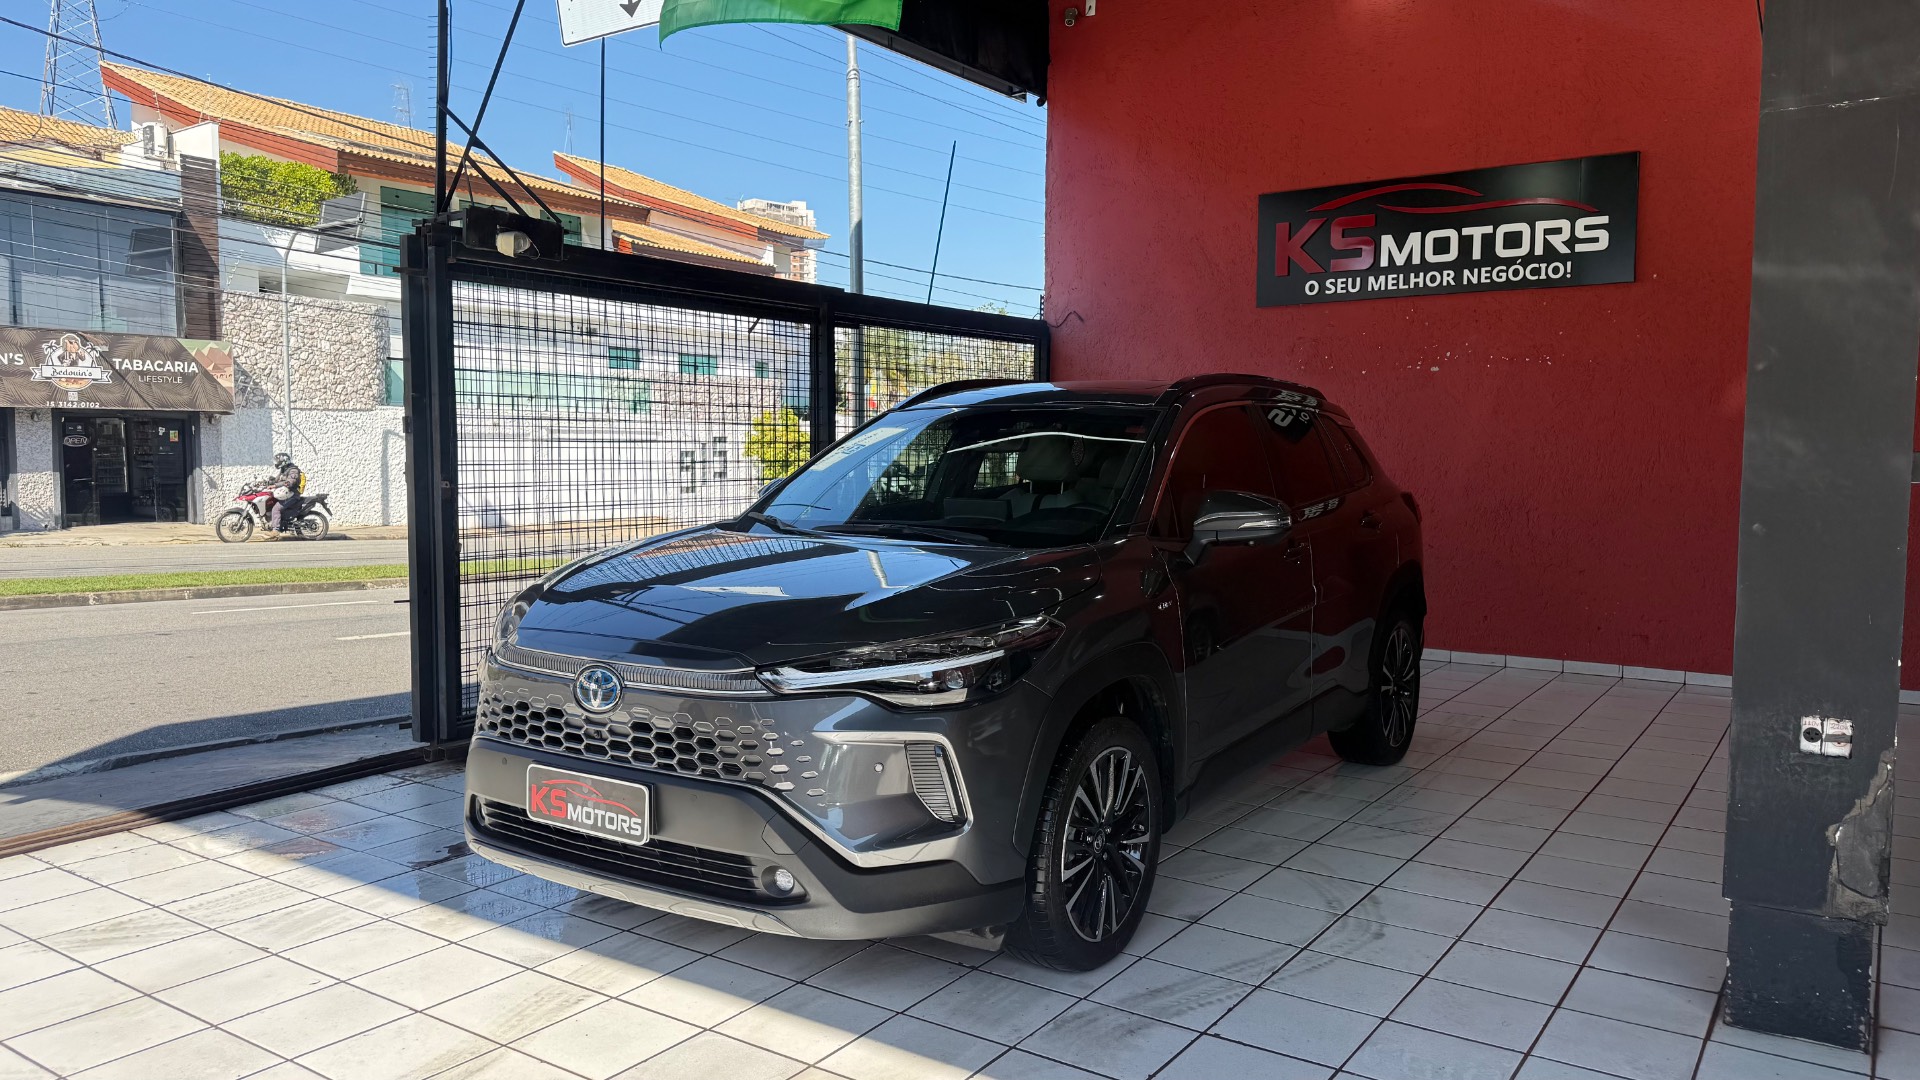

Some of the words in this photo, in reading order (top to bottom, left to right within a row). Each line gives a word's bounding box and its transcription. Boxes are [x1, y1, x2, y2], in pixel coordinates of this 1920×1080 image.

[1274, 213, 1376, 277] KS
[1380, 215, 1610, 268] MOTORS
[1304, 279, 1321, 296] O
[1325, 276, 1362, 295] SEU
[1367, 270, 1456, 291] MELHOR
[1463, 259, 1573, 285] NEGÓCIO!
[50, 366, 93, 377] Bedouin's
[112, 358, 199, 373] TABACARIA
[138, 375, 183, 384] LIFESTYLE
[531, 784, 567, 819] KS
[567, 802, 642, 836] MOTORS
